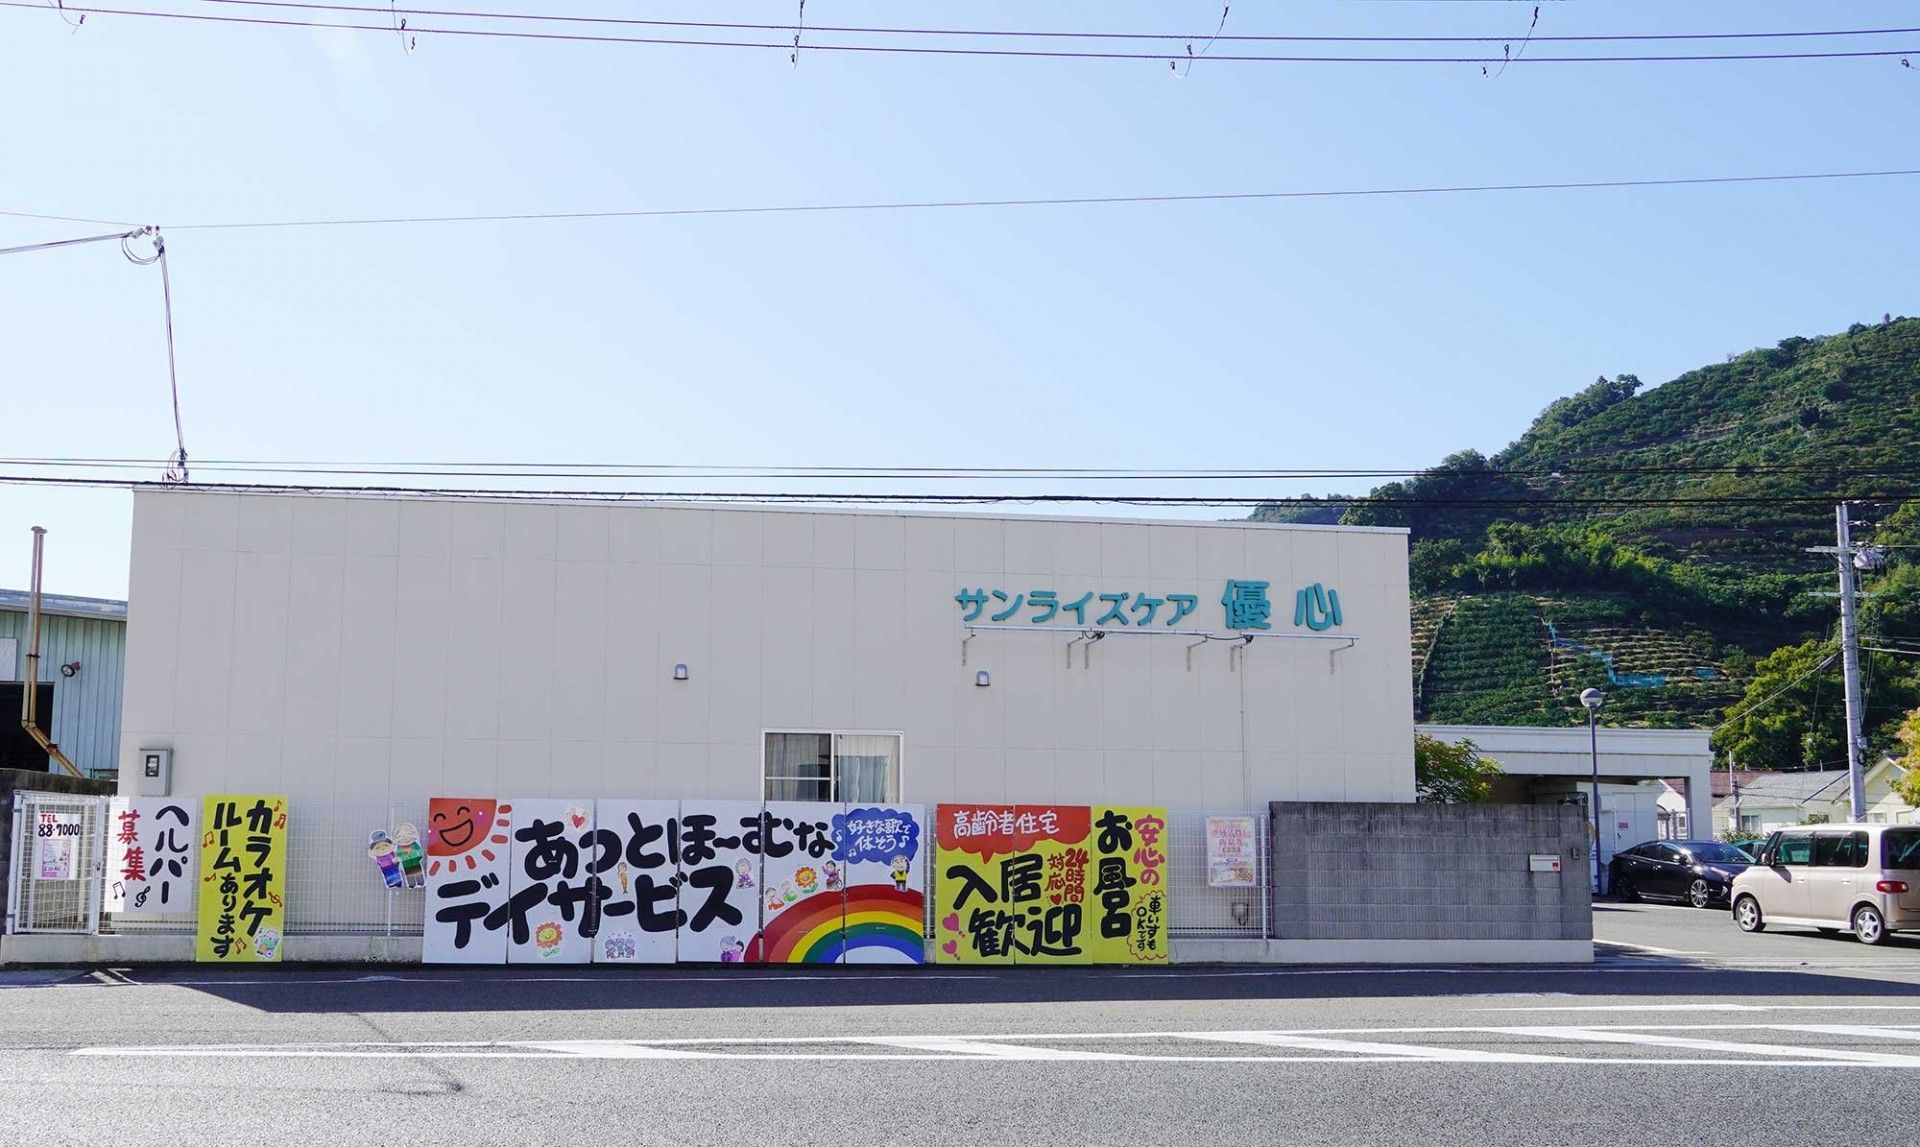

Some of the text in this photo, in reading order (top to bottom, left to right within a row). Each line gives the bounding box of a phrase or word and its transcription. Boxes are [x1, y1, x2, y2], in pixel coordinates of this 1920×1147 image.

[955, 588, 1198, 626] サンライズケア
[40, 813, 58, 823] TEL
[117, 809, 146, 881] 募集
[847, 818, 912, 835] 好きな歌で
[953, 810, 1060, 839] 高齢者住宅
[149, 804, 190, 904] ヘルパー
[239, 800, 274, 937] カラオケ
[1045, 853, 1066, 891] 対応
[1064, 848, 1089, 904] 24時間
[1093, 810, 1137, 938] お風呂
[1133, 814, 1165, 885] 安心の
[210, 802, 242, 958] ルームあります
[436, 865, 743, 949] デイサービス
[946, 854, 1044, 910] 入居
[968, 904, 1082, 957] 歓迎
[1136, 906, 1147, 951] OKです
[1146, 895, 1161, 950] 車いすも
